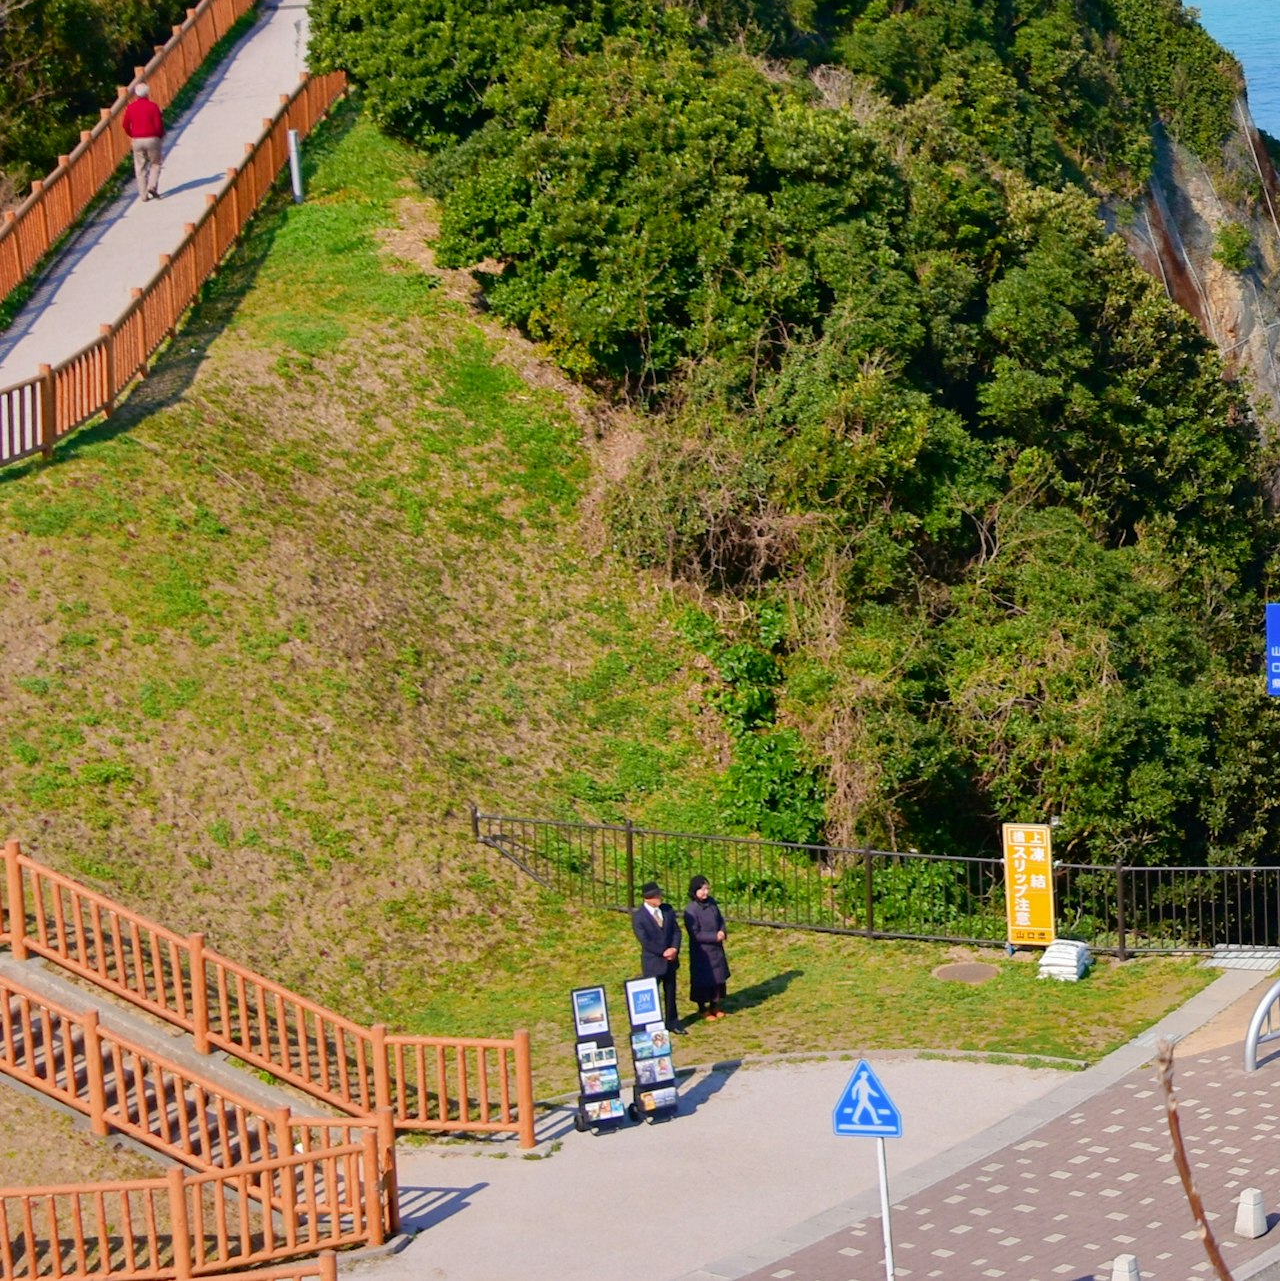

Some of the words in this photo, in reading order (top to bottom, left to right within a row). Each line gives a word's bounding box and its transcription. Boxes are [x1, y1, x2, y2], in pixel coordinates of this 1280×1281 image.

[1012, 831, 1043, 844] 橋上
[1030, 847, 1047, 889] 凍結
[1013, 846, 1031, 925] スリップ注意
[1016, 931, 1046, 940] 山口県
